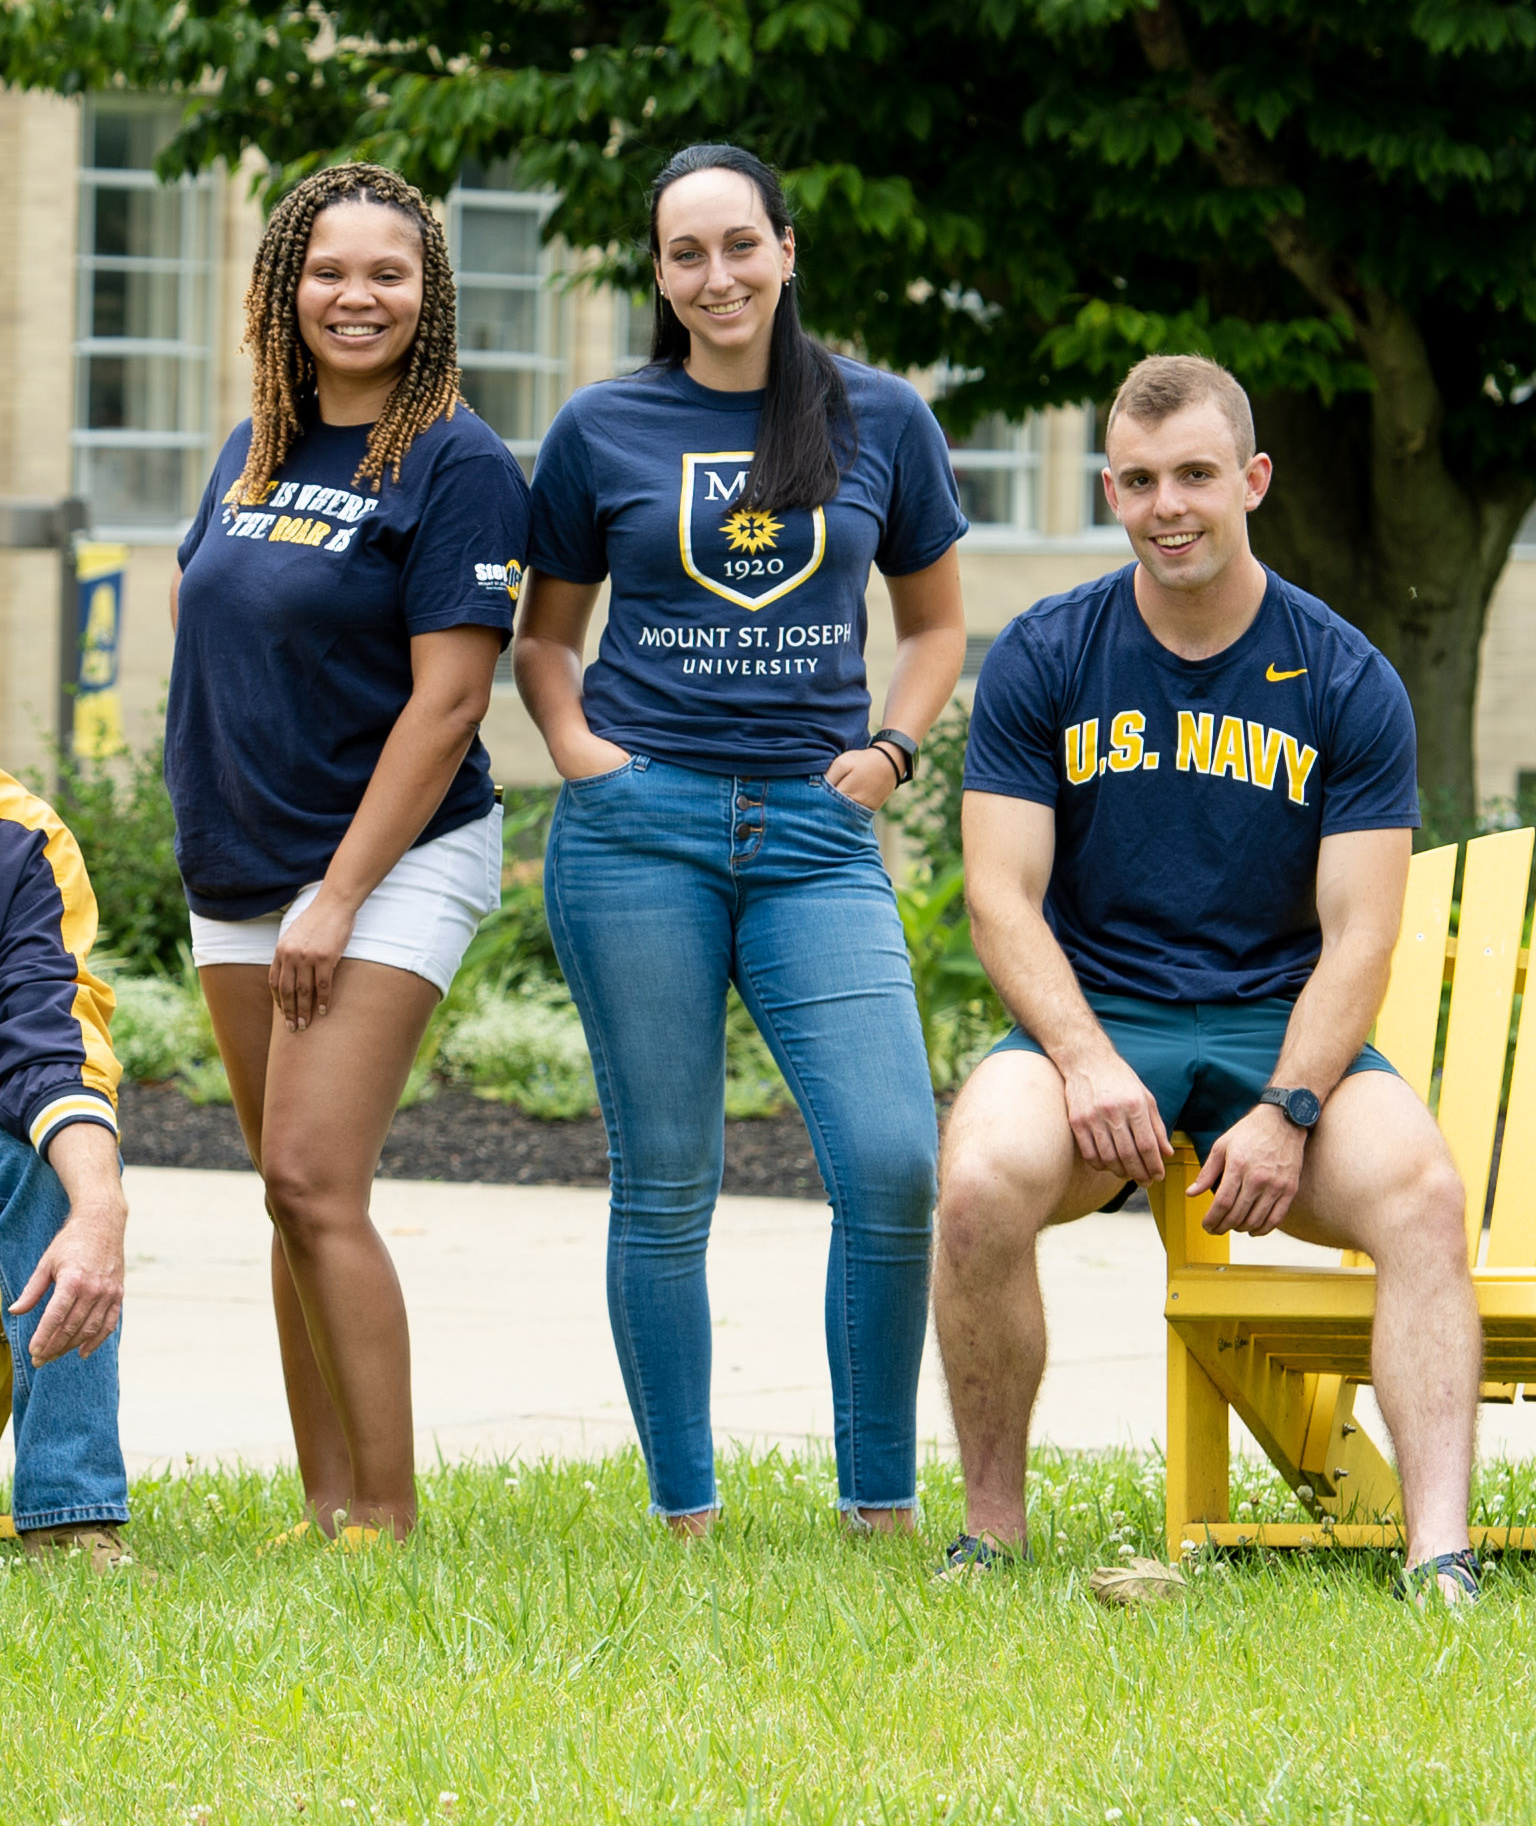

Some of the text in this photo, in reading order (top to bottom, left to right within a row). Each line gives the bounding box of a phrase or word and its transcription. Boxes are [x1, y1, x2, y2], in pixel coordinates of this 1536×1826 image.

[269, 481, 300, 508] IS
[226, 512, 358, 552] THE ROAR IS
[723, 557, 785, 580] 1920
[638, 622, 852, 652] MOUNT ST. JOSEPH
[682, 657, 819, 676] UNIVERSITY
[1064, 709, 1318, 806] U.S. NAVY
